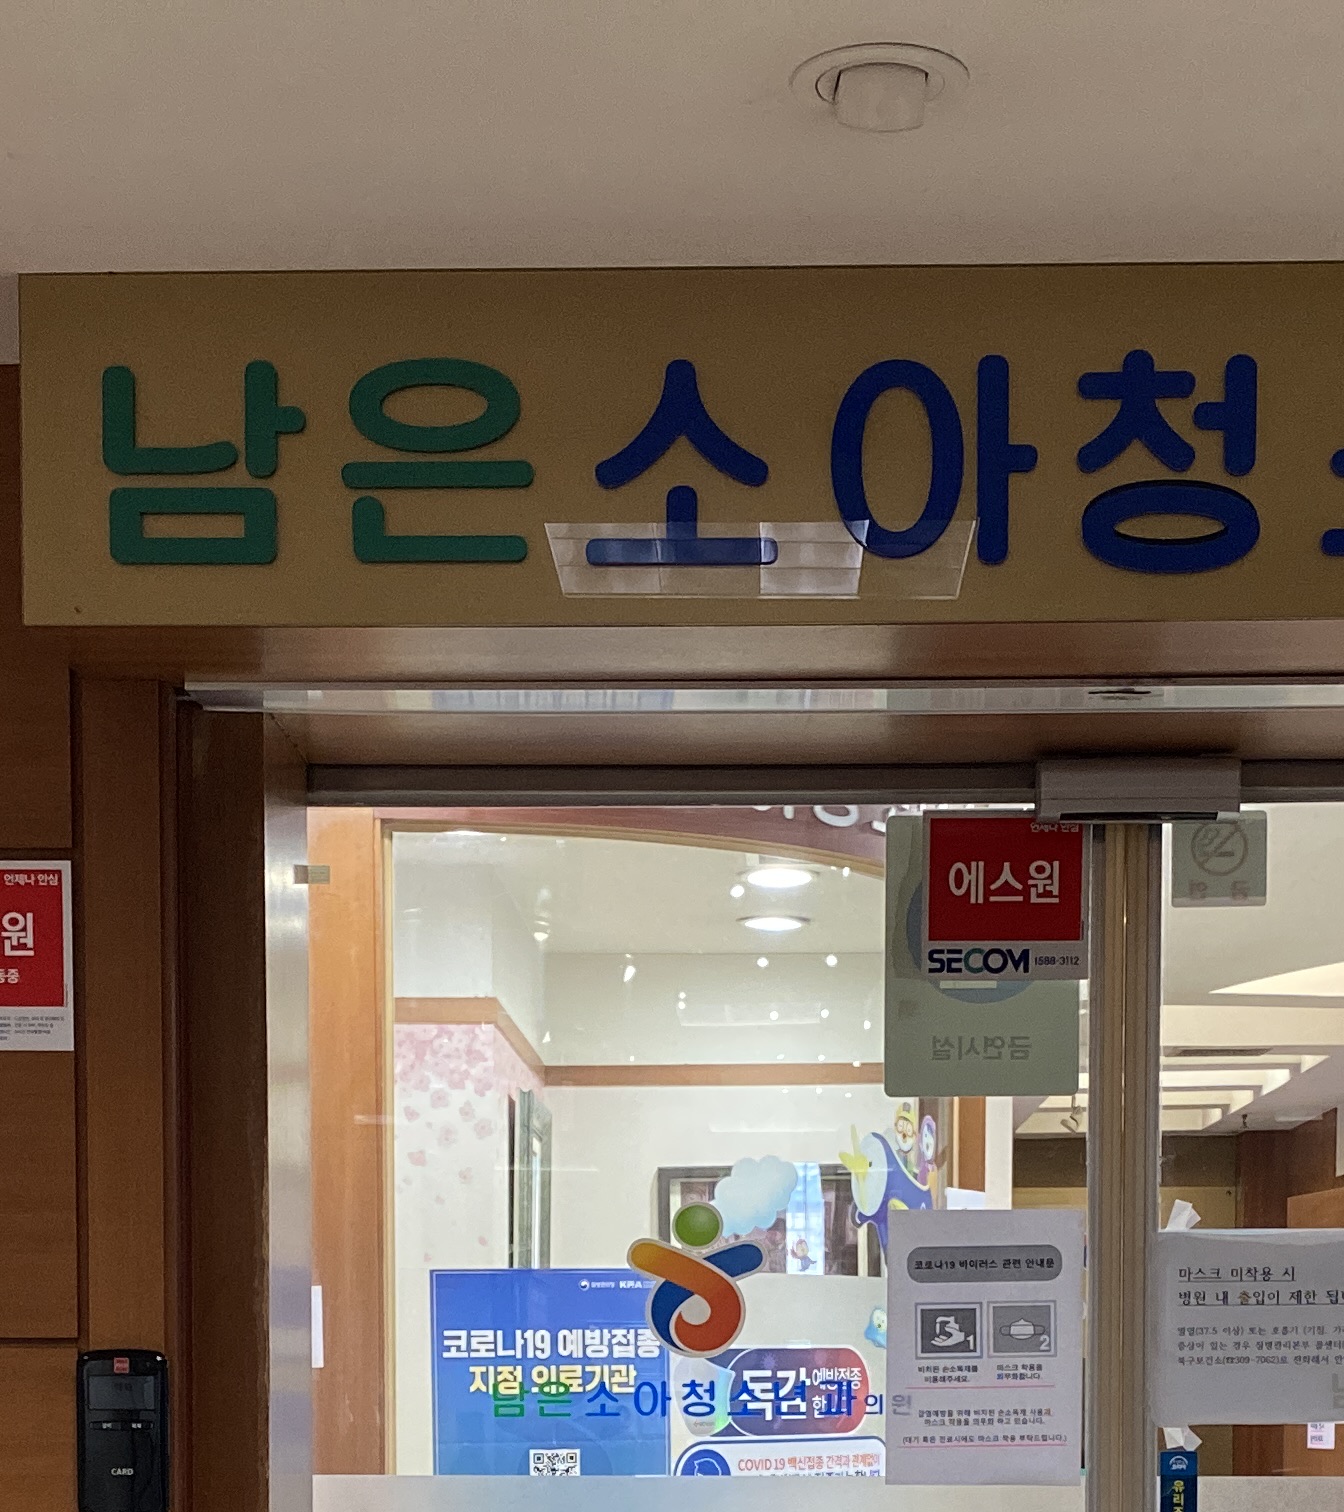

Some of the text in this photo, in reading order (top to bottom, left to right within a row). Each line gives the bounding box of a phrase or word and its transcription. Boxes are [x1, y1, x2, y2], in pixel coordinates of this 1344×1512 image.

[3, 873, 60, 887] 언제나 안심
[948, 859, 1061, 905] 에스원
[927, 948, 1031, 975] SECOM
[1178, 1265, 1296, 1282] 마스크 미착용 시
[1178, 1290, 1206, 1306] 병원
[1215, 1290, 1230, 1305] 내
[1237, 1289, 1281, 1305] 출입이
[1288, 1289, 1318, 1305] 제한
[442, 1328, 661, 1359] 코로나19 예방접종
[468, 1364, 523, 1395] 지정
[110, 1467, 134, 1477] CARD
[737, 1457, 773, 1472] COVID
[774, 1457, 786, 1471] 19
